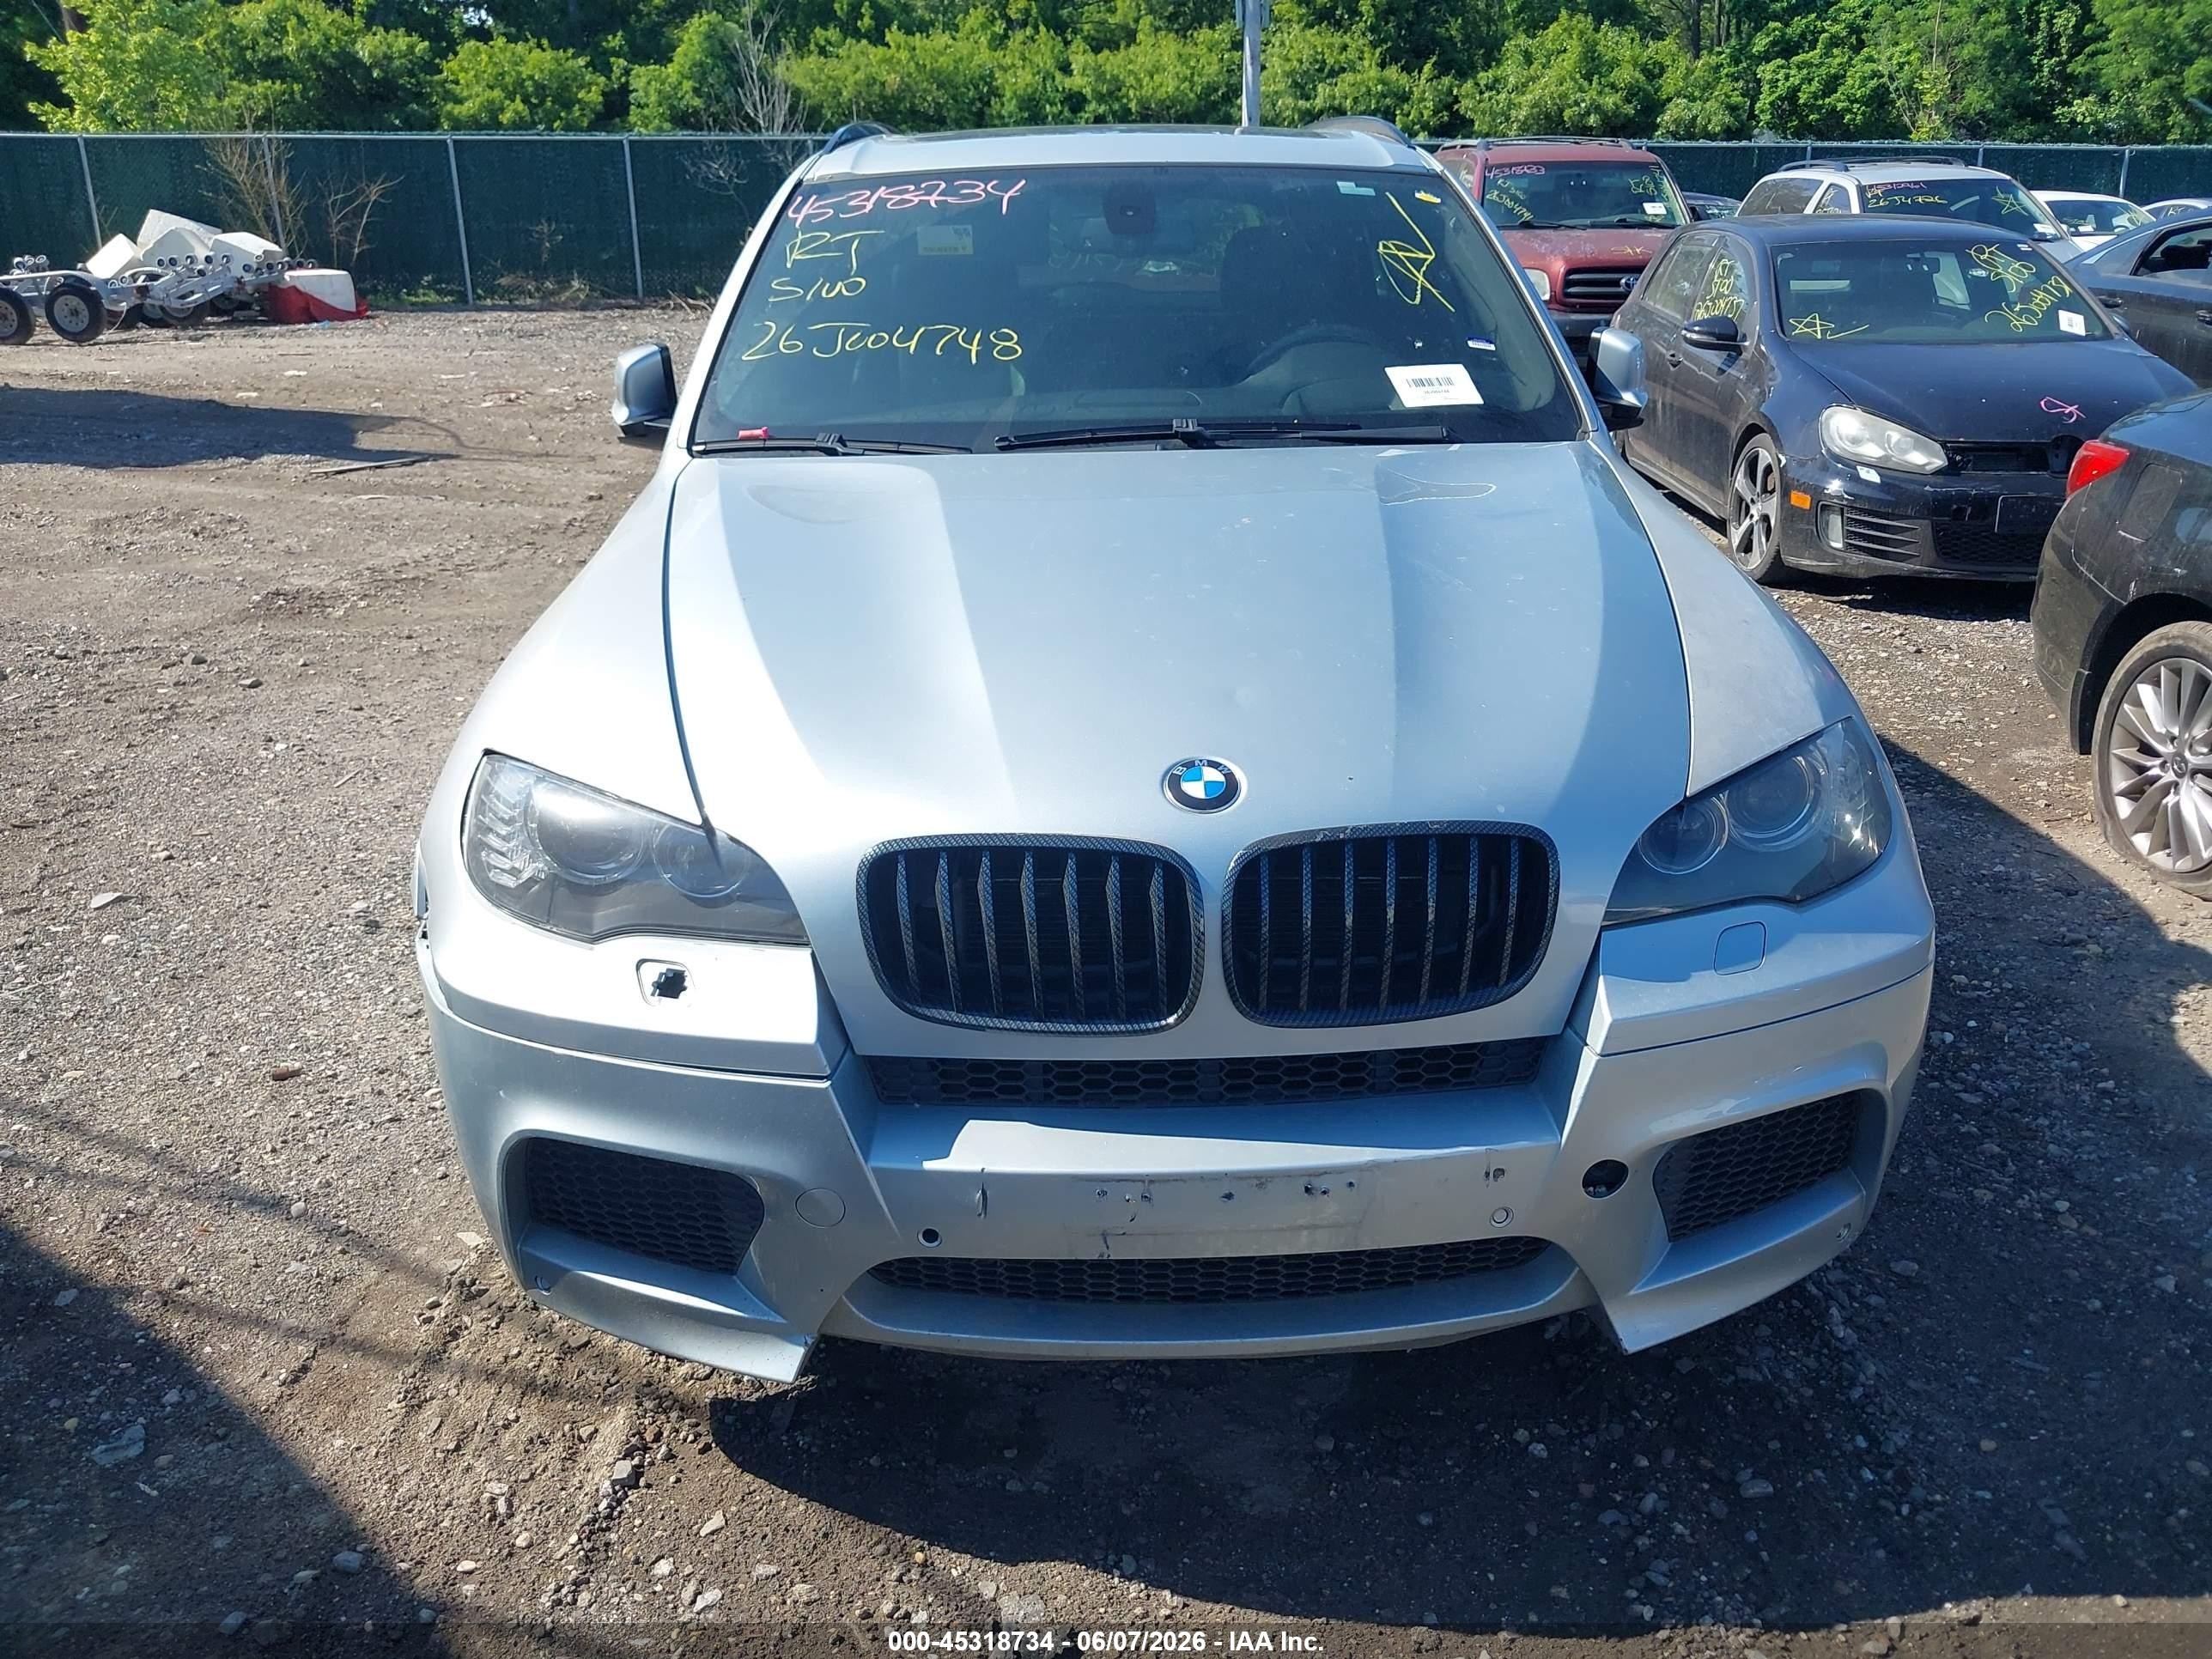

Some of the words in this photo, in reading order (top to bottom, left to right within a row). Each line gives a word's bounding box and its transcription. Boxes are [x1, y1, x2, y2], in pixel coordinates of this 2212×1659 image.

[787, 179, 1027, 228] 45318734
[785, 227, 885, 275] RT
[1173, 760, 1232, 775] BMW
